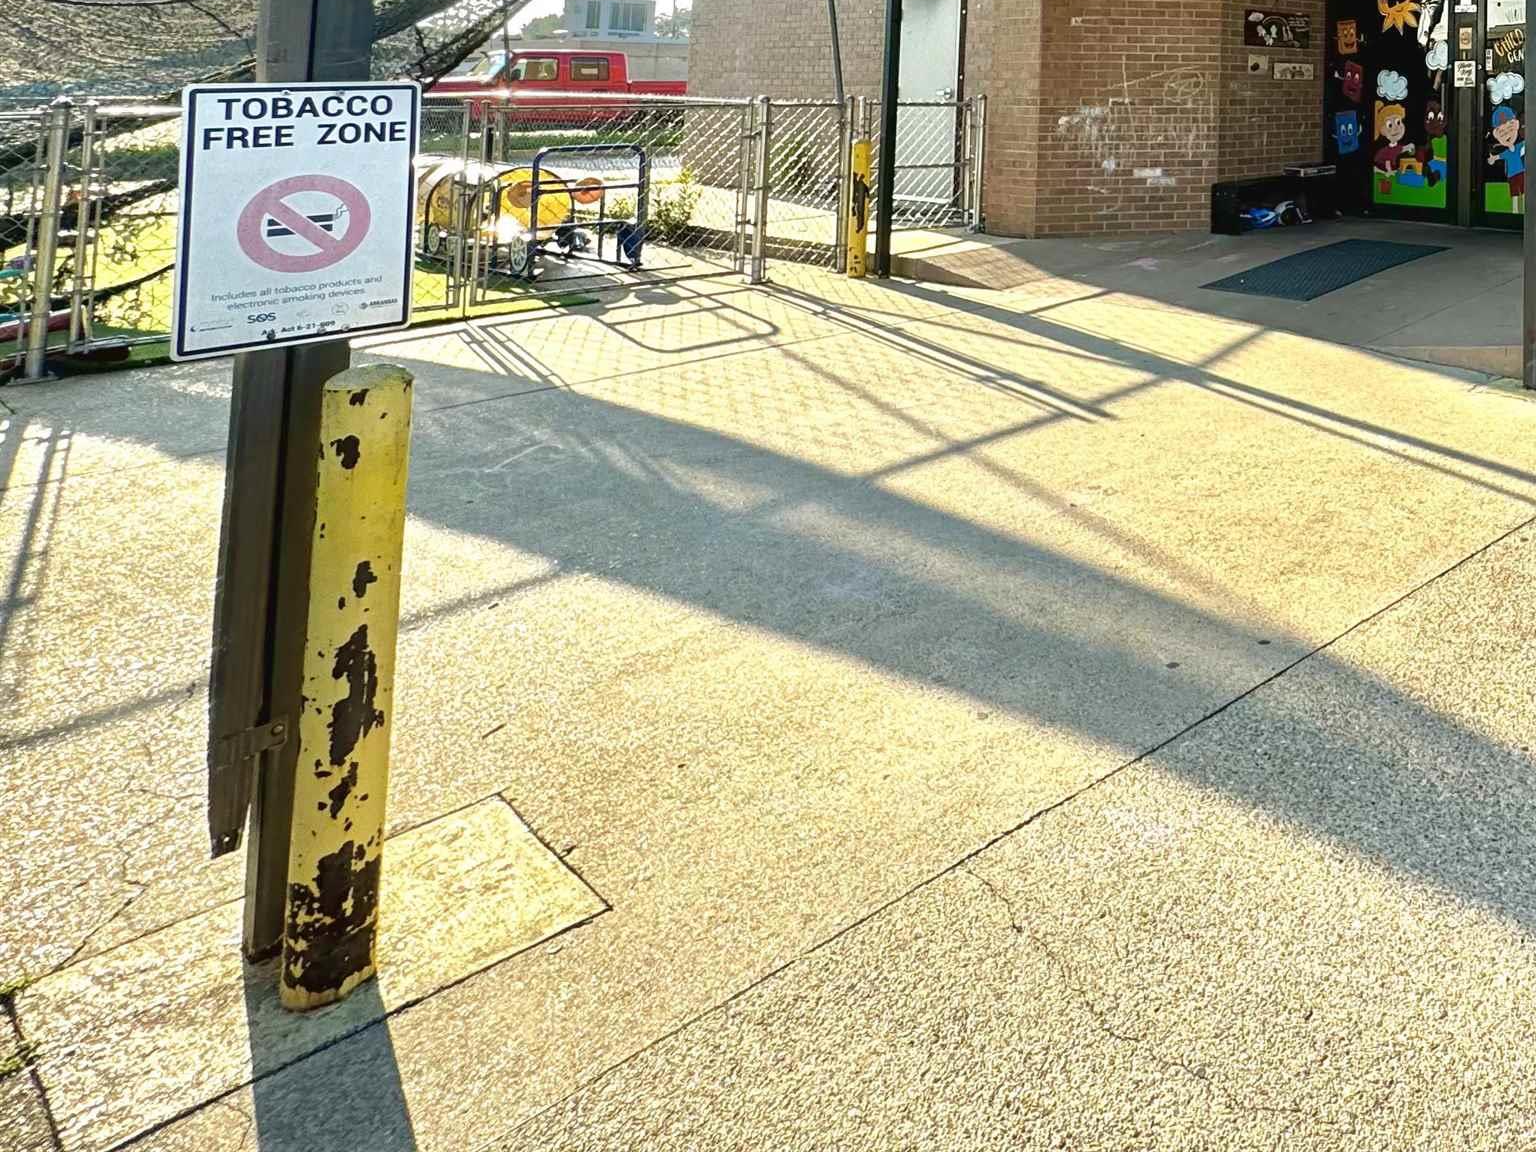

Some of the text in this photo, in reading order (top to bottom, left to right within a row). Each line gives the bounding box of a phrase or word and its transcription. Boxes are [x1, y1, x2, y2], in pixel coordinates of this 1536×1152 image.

[1494, 29, 1524, 57] CHILD
[1507, 49, 1525, 63] CEN
[217, 95, 393, 121] TOBACCO
[203, 121, 407, 150] FREE ZONE
[211, 275, 383, 302] Includes all tobacco products and
[227, 297, 279, 309] electronic
[281, 292, 326, 304] smoking
